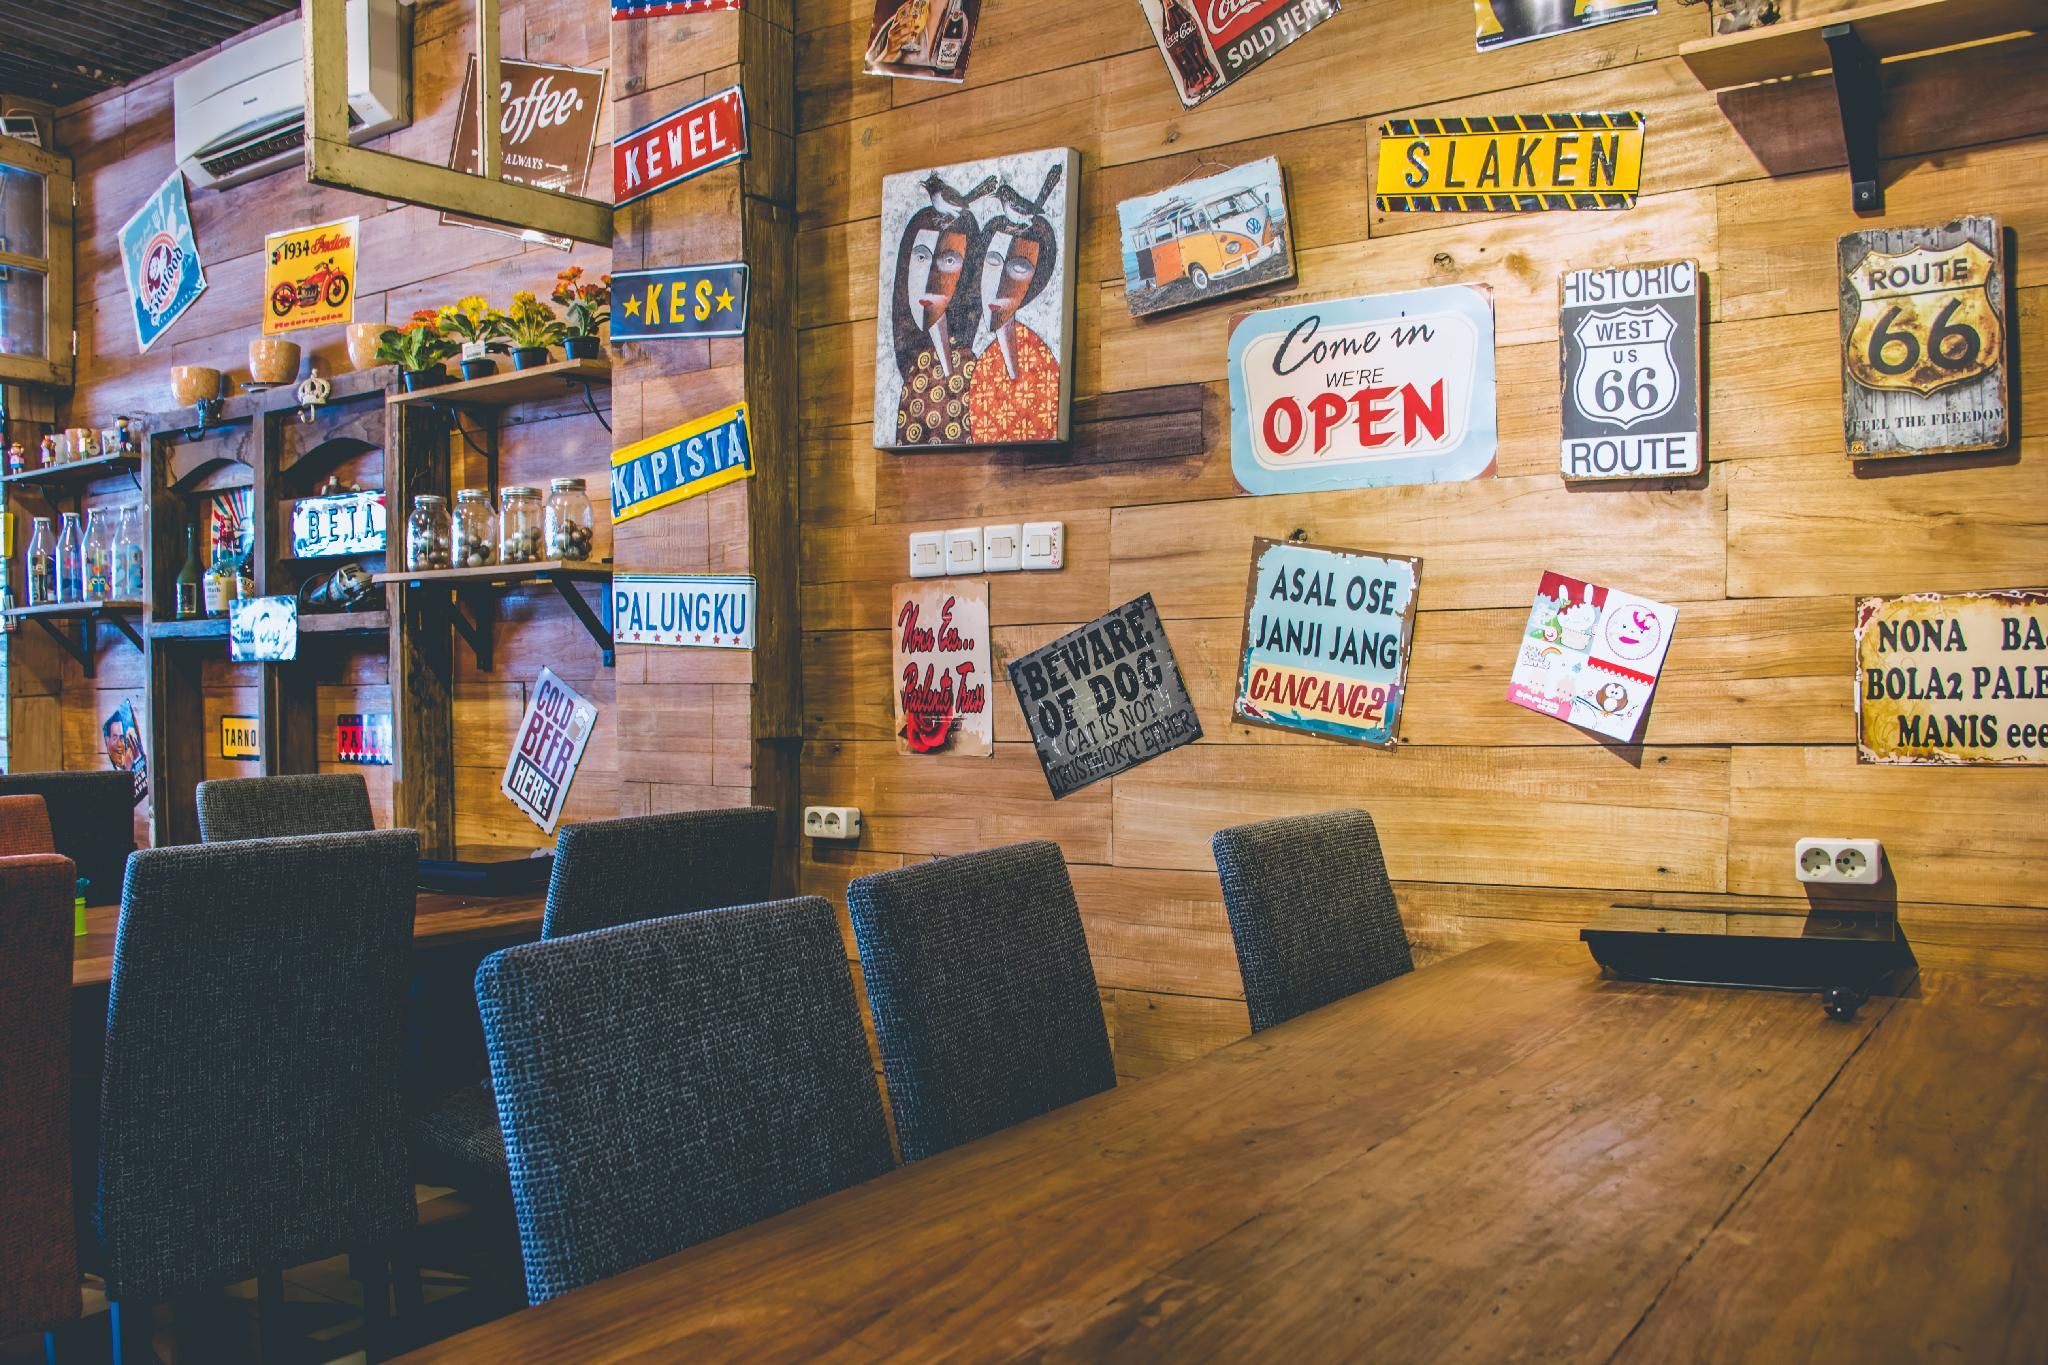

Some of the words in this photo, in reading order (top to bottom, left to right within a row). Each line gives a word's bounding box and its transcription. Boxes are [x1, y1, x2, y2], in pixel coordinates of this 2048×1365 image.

[1227, 25, 1276, 68] SOLD
[504, 155, 544, 170] ALWAYS
[624, 109, 727, 190] KEWEL
[1405, 133, 1620, 188] SLAKEN
[284, 239, 310, 260] 1934
[311, 233, 352, 255] Indian
[149, 246, 183, 322] Seafood
[1566, 262, 1690, 303] HISTORIC
[1868, 257, 1968, 291] ROUTE
[274, 312, 343, 329] Motorcycles
[645, 279, 713, 325] KES
[1272, 315, 1381, 377] Come
[1391, 321, 1435, 348] in
[1596, 319, 1654, 342] WEST
[1868, 297, 1981, 375] 66
[1326, 368, 1384, 389] WE'RE
[1595, 367, 1659, 412] 66
[1263, 377, 1449, 456] OPEN
[1853, 418, 1890, 432] FEEL
[1895, 415, 1926, 428] THE
[1931, 408, 2005, 425] FREEDOM
[612, 422, 746, 508] KAPISTA
[1571, 436, 1687, 474] ROUTE
[308, 503, 376, 545] BETA
[1270, 564, 1337, 607] ASAL
[1346, 576, 1397, 616] OSE
[615, 591, 746, 635] PALUNGKU
[898, 600, 935, 654] Nona
[1877, 618, 1968, 652] NONA
[2001, 616, 2048, 651] BA
[1023, 609, 1155, 702] BEWARE
[1256, 615, 1323, 658] JANJI
[1329, 626, 1398, 669] JANG
[536, 679, 575, 731] COLD
[1038, 688, 1079, 739] OF
[1088, 650, 1164, 717] DOG
[1866, 666, 1963, 701] BOLA2
[1972, 665, 2048, 699] PALE
[225, 728, 257, 747] TARNO
[520, 710, 575, 785] BEER
[1064, 719, 1099, 756] CAT
[1099, 710, 1119, 741] IS
[1122, 694, 1158, 731] NOT
[1139, 708, 1195, 753] EITHER
[1898, 714, 1998, 748] MANIS
[2007, 723, 2048, 748] eee
[512, 758, 551, 817] HERE!
